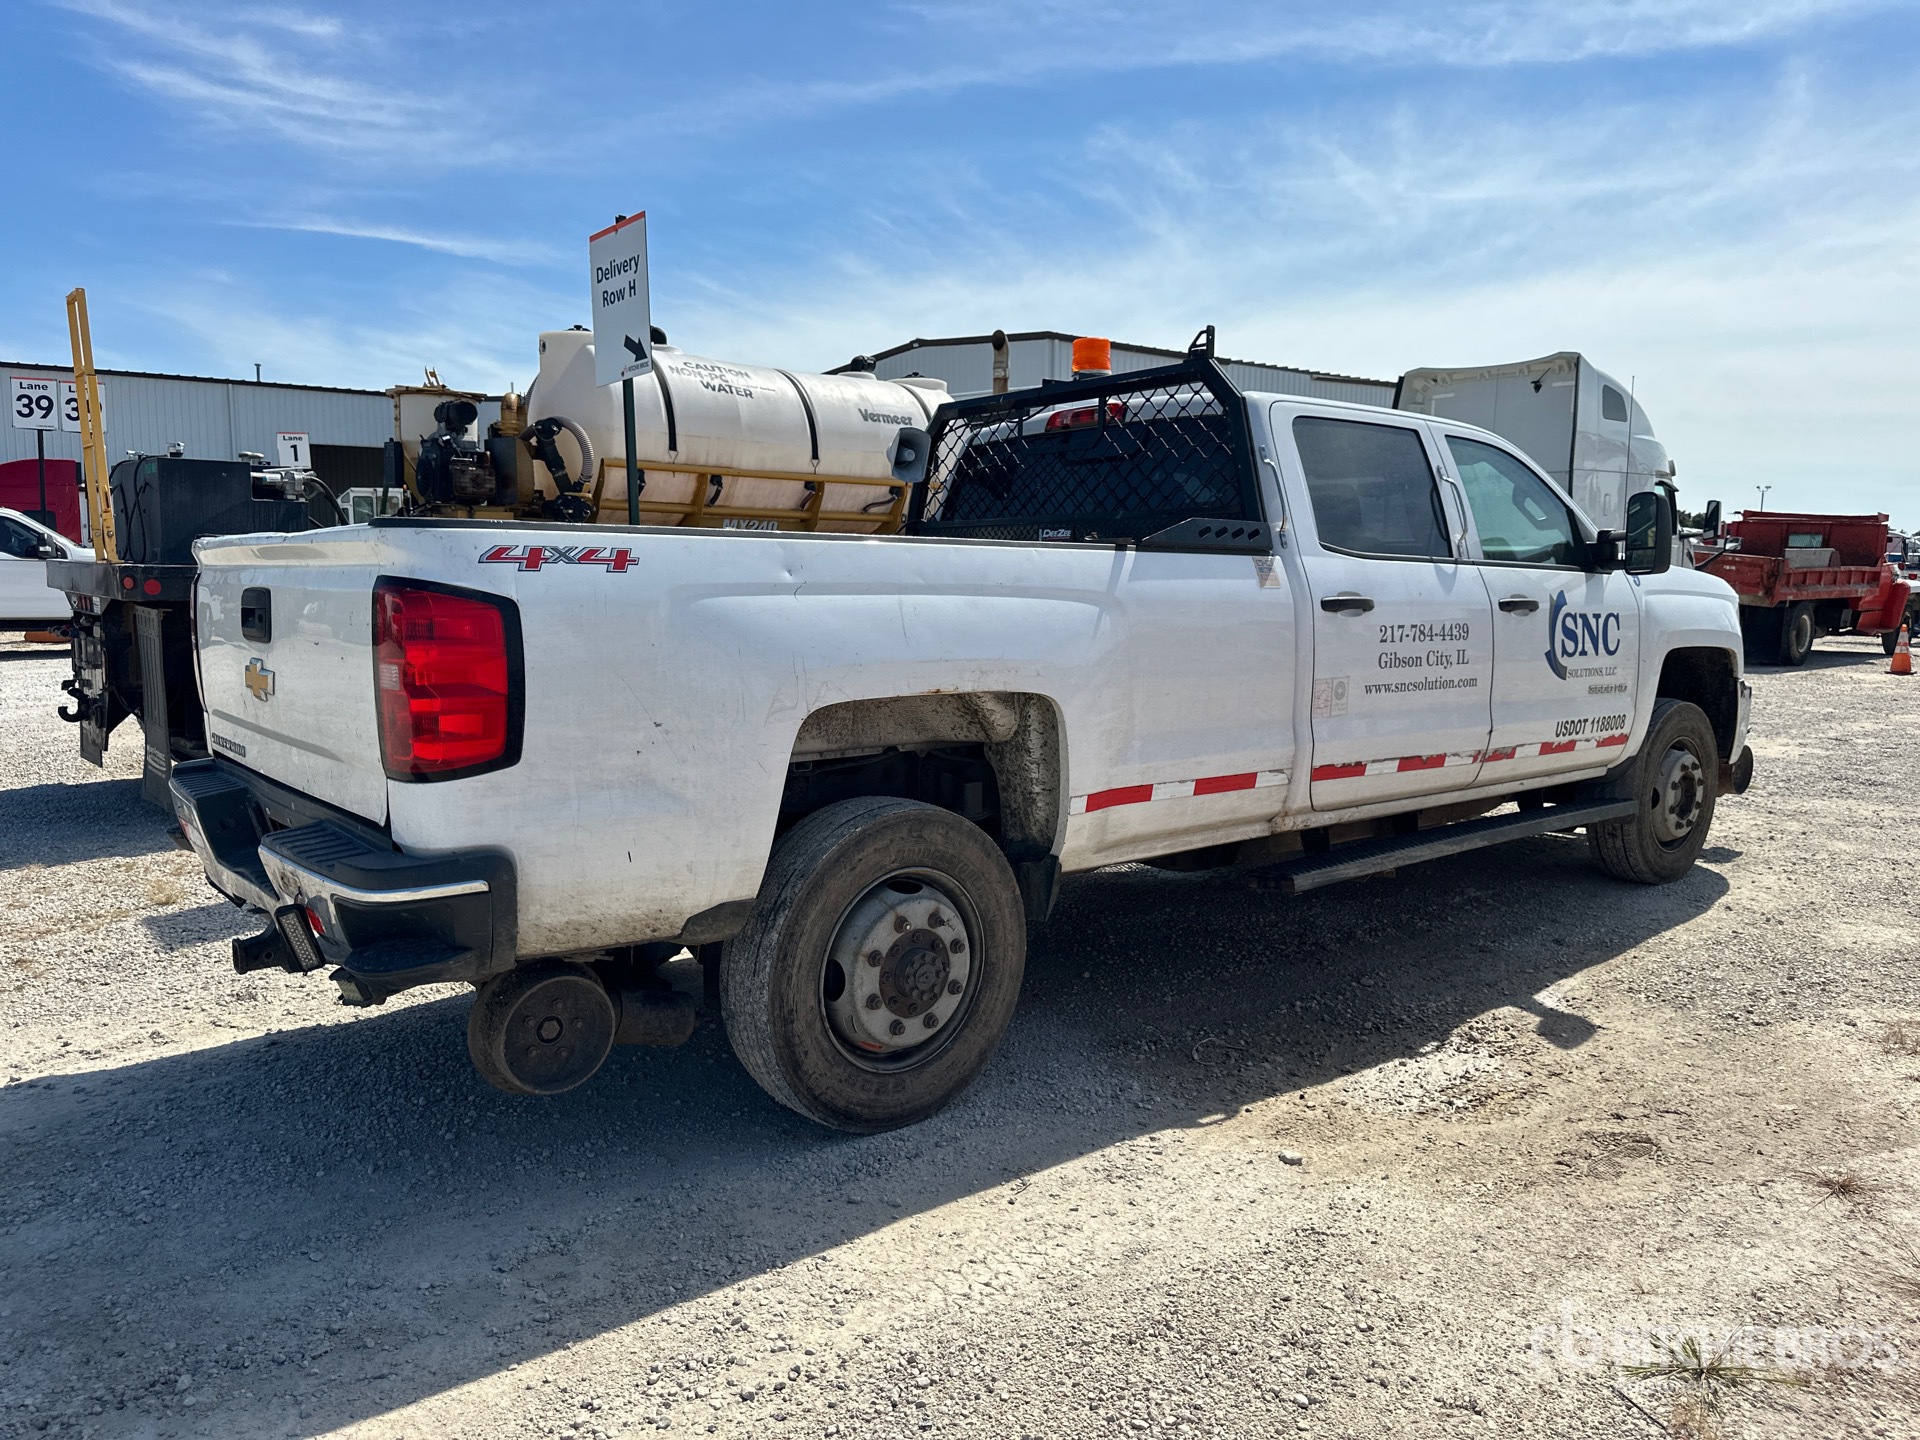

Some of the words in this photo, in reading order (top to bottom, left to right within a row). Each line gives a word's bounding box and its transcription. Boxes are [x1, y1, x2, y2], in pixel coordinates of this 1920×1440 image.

[596, 254, 640, 284] Delivery
[602, 286, 626, 308] Row
[628, 278, 637, 298] H
[683, 361, 751, 380] CAUTION
[19, 381, 49, 391] Lane
[700, 380, 755, 399] WATER
[15, 393, 54, 419] 39
[857, 408, 913, 426] Vermeer
[290, 444, 299, 462] 1
[1379, 622, 1470, 643] 217-784-4439
[1561, 612, 1620, 658] SNC
[1378, 651, 1423, 669] Gibson
[1426, 650, 1453, 670] City,
[1456, 649, 1469, 665] IL
[1567, 667, 1604, 679] SOLUTIONS,
[1605, 666, 1617, 676] LLC
[1364, 676, 1478, 695] www.sncsolution.com
[1555, 718, 1588, 738] USDOT
[1590, 713, 1626, 734] 1188008
